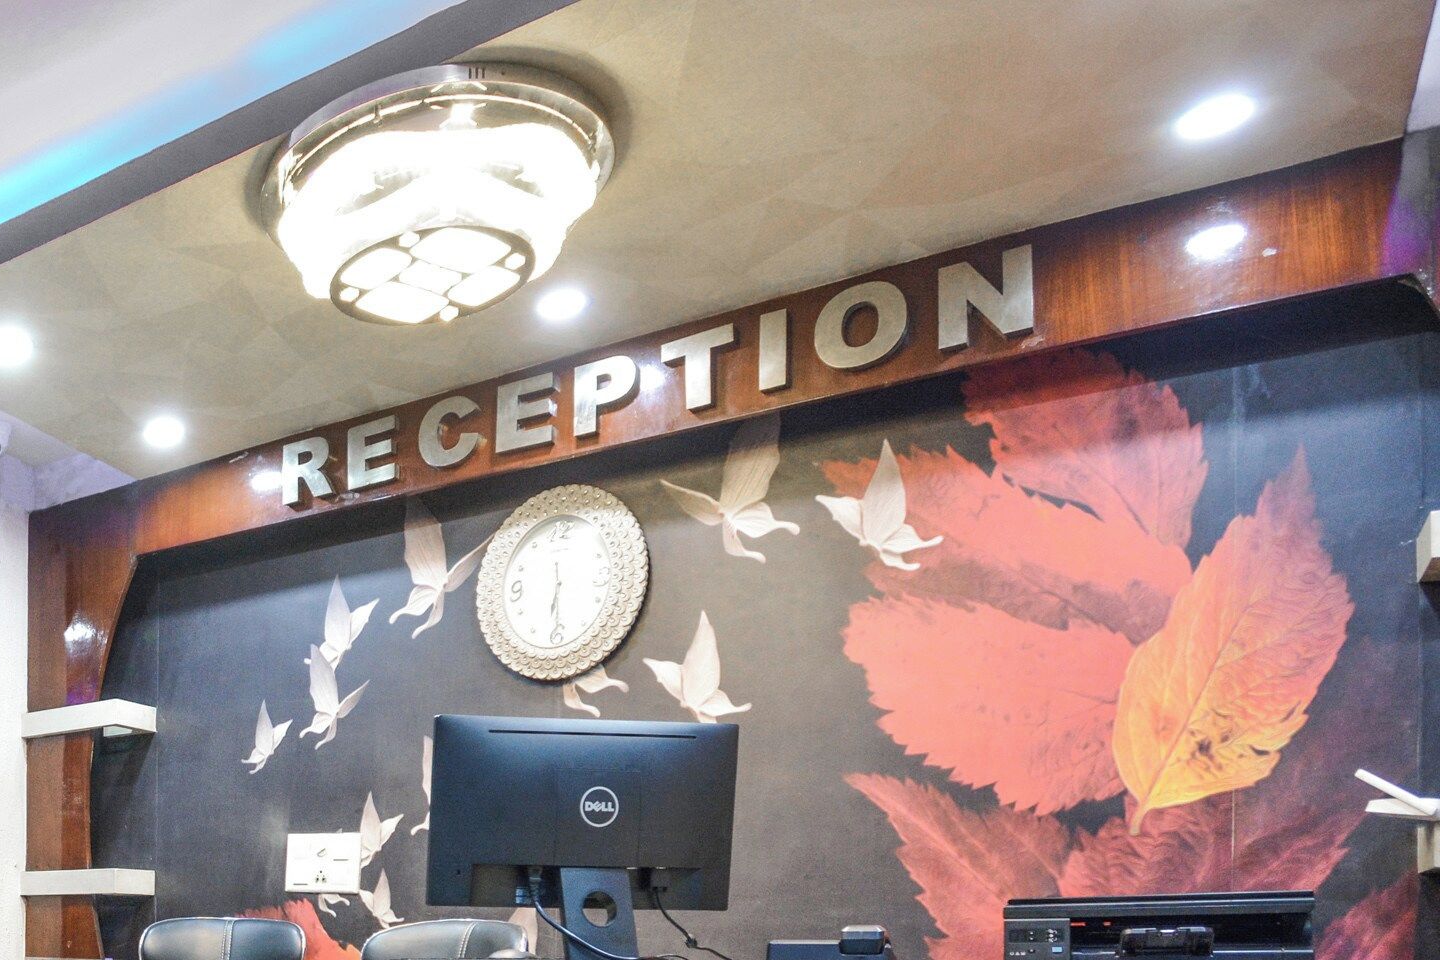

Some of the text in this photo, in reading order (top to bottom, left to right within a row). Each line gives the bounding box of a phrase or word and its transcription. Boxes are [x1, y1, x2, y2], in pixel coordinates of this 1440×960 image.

[281, 243, 1035, 506] RECEPTION
[510, 580, 523, 603] 9
[549, 623, 566, 645] 6
[584, 801, 615, 812] DELL
